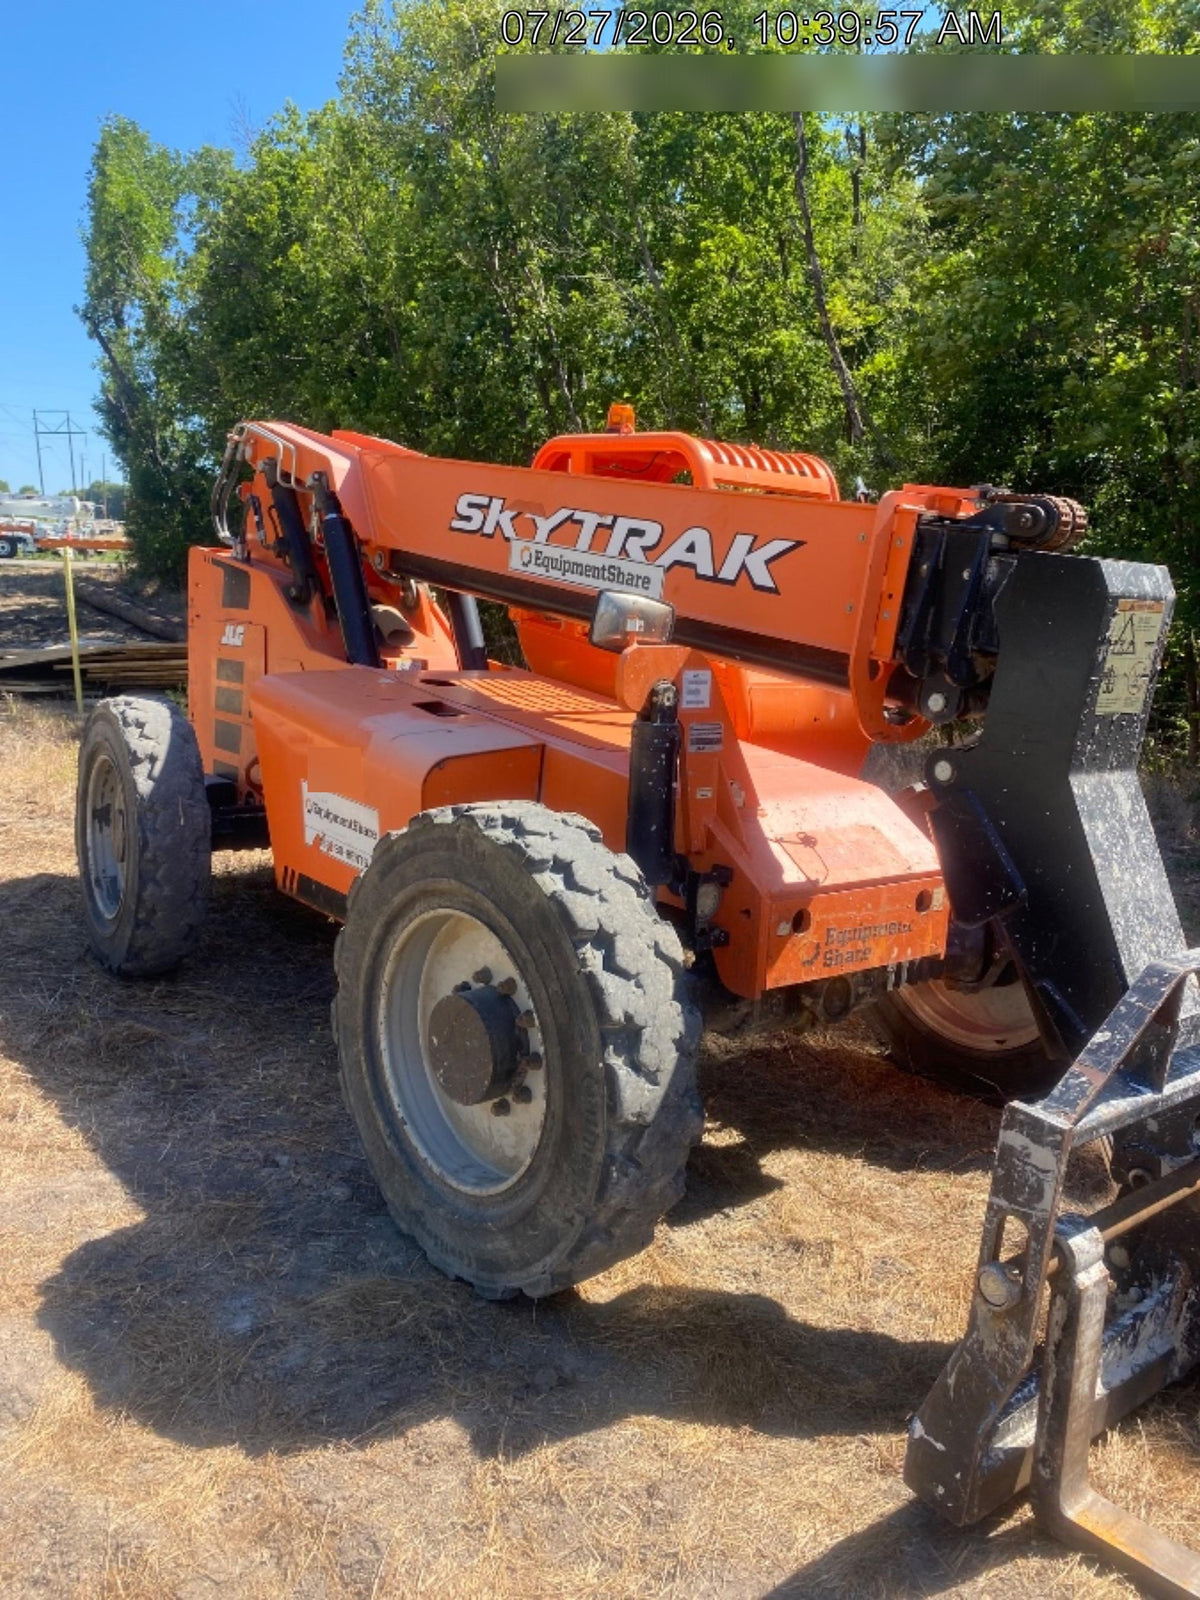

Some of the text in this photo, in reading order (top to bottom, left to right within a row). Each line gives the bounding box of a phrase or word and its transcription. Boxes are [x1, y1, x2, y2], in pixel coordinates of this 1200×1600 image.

[449, 492, 807, 596] SKYTRAK
[533, 549, 652, 591] EquipmentShare
[220, 624, 244, 646] JLG
[823, 947, 873, 968] Share
